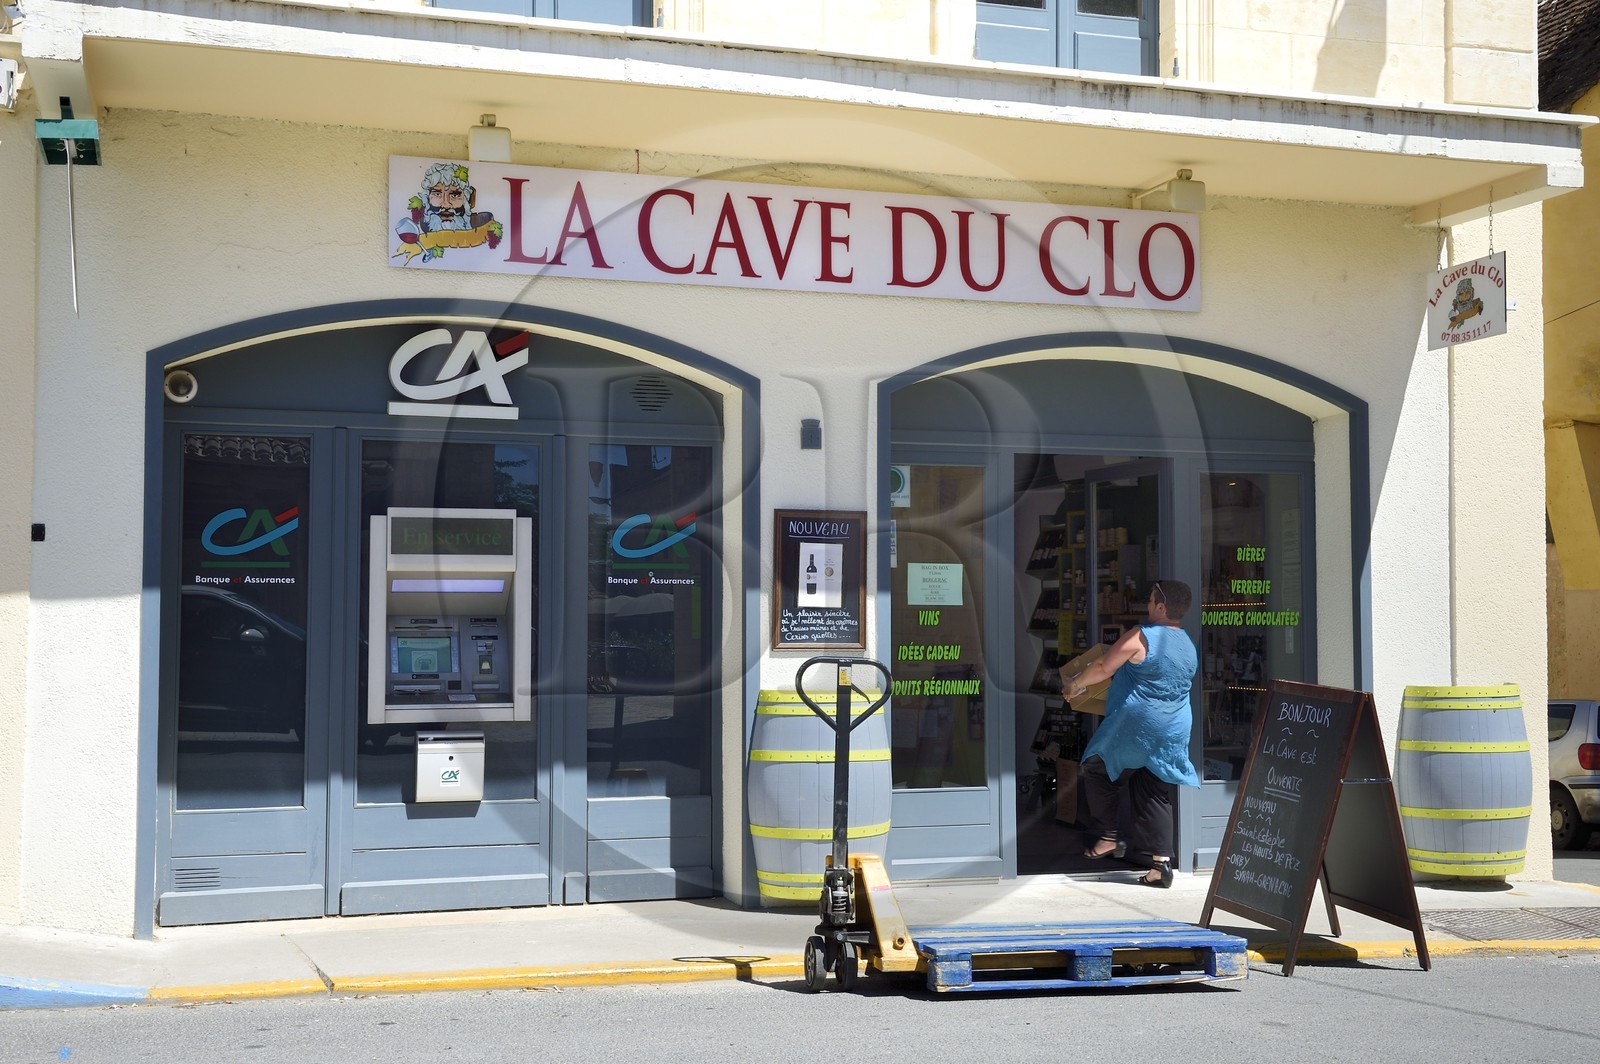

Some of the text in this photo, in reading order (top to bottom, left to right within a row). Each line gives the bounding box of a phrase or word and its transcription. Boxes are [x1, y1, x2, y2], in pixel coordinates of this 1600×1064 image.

[502, 176, 1195, 302] LA CAVE DU CLO
[1428, 261, 1504, 308] La Cave du Clo
[1441, 320, 1491, 342] 07 88 35 11 17
[402, 527, 502, 546] En service
[788, 520, 850, 536] NOUVEAU
[1236, 543, 1266, 562] BIÈRES
[195, 575, 231, 584] Banque
[244, 575, 296, 584] Assurances
[607, 576, 639, 585] Banque
[650, 577, 695, 585] Assurances
[1231, 579, 1271, 595] VERRERIE
[782, 609, 794, 618] Un
[796, 608, 823, 622] plaisir
[825, 617, 835, 626] des
[919, 610, 940, 626] VINS
[1201, 607, 1300, 626] DOUCEURS CHOCOLATÉES
[780, 624, 789, 632] de
[897, 642, 961, 661] IDÉES CADEAU
[923, 676, 981, 696] RÉGIONNAUX
[1277, 702, 1332, 728] BONJOUR
[1244, 796, 1277, 814] NOUVEAU
